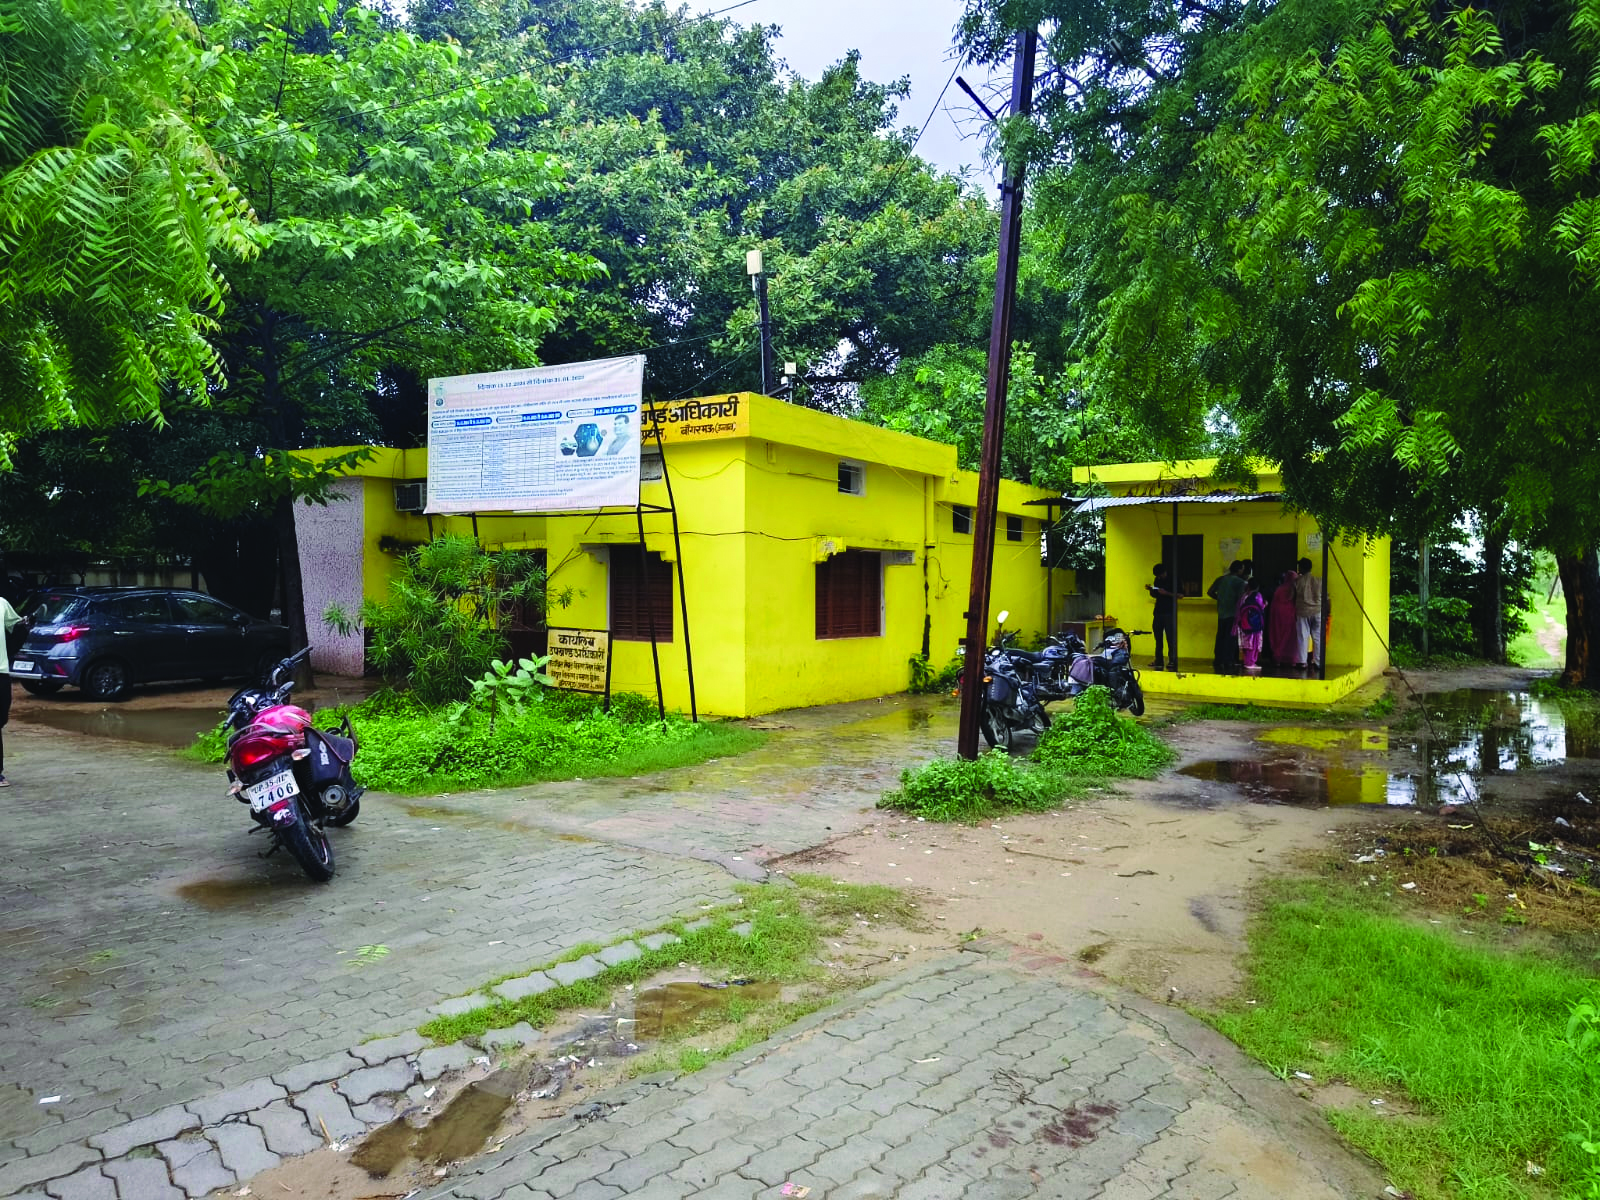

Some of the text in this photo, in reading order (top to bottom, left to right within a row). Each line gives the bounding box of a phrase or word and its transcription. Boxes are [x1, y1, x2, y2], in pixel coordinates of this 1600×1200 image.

[669, 395, 740, 423] अधिकारी
[558, 632, 596, 647] कार्यालय
[258, 783, 294, 807] 7406
